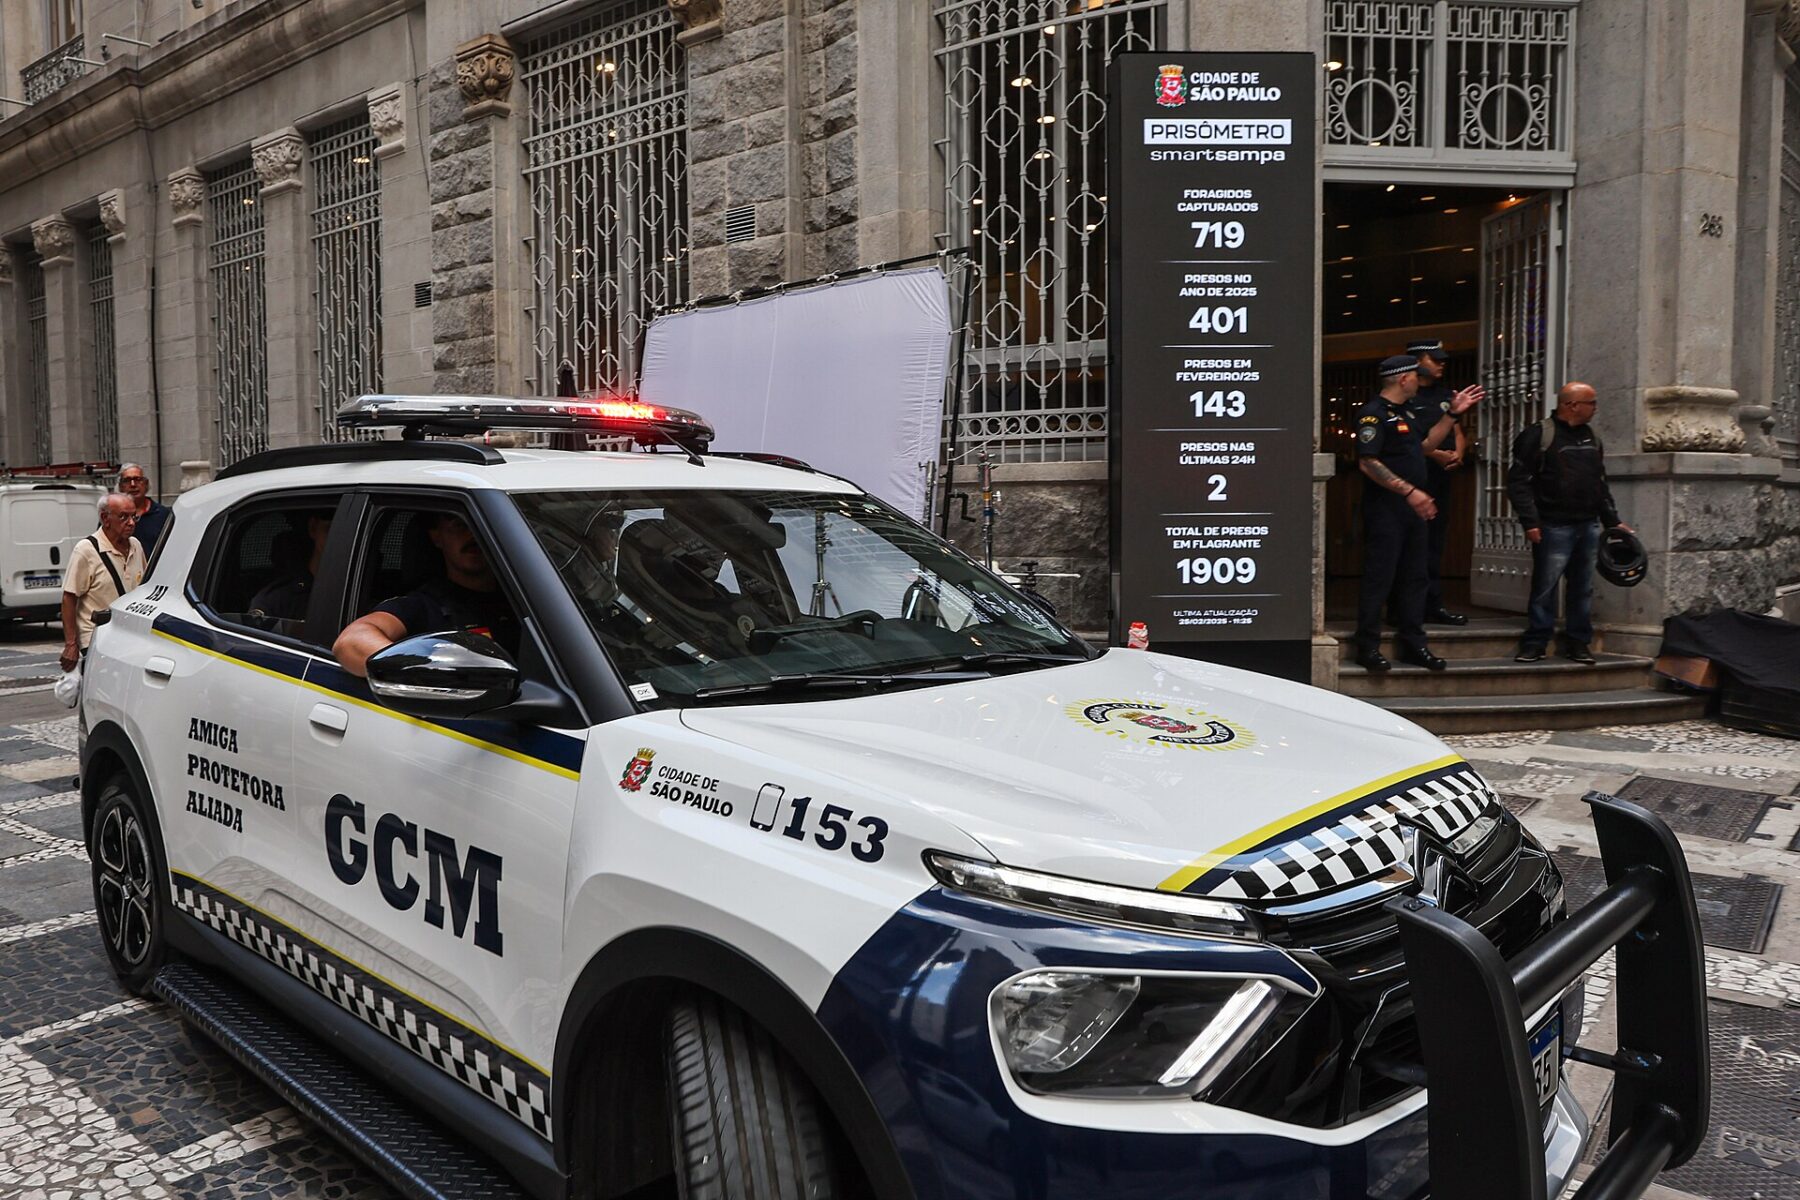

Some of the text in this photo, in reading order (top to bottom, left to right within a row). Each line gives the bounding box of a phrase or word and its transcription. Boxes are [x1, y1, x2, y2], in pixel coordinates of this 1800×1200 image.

[1191, 72, 1259, 84] CIDADE DE
[1191, 85, 1281, 101] SÃO PAULO
[1152, 121, 1284, 139] PRISÔMETRO
[1151, 149, 1285, 164] smartsampa
[1184, 189, 1252, 199] FORAGIDOS
[1178, 202, 1258, 212] CAPTURADOS
[1192, 222, 1244, 248] 719
[1185, 274, 1251, 284] PRESOS NO
[1179, 287, 1257, 297] ANO DE 2025
[1189, 307, 1247, 333] 401
[1185, 359, 1251, 369] PRESOS EM
[1176, 371, 1259, 382] FEVEREIRO/25
[1190, 391, 1245, 417] 143
[1181, 441, 1254, 452] PRESOS NAS
[1180, 453, 1255, 465] ÚLTIMAS 24H
[1208, 475, 1226, 500] 2
[1165, 526, 1268, 537] TOTAL DE PRESOS
[1173, 538, 1261, 550] EM FLAGRANTE
[1177, 558, 1256, 584] 1909
[189, 718, 238, 753] AMIGA
[187, 754, 285, 811] PROTETORA
[658, 766, 719, 792] CIDADE DE
[650, 780, 733, 816] SÃO PAULO
[186, 791, 242, 832] ALIADA
[783, 797, 888, 862] 153
[325, 794, 503, 957] GCM
